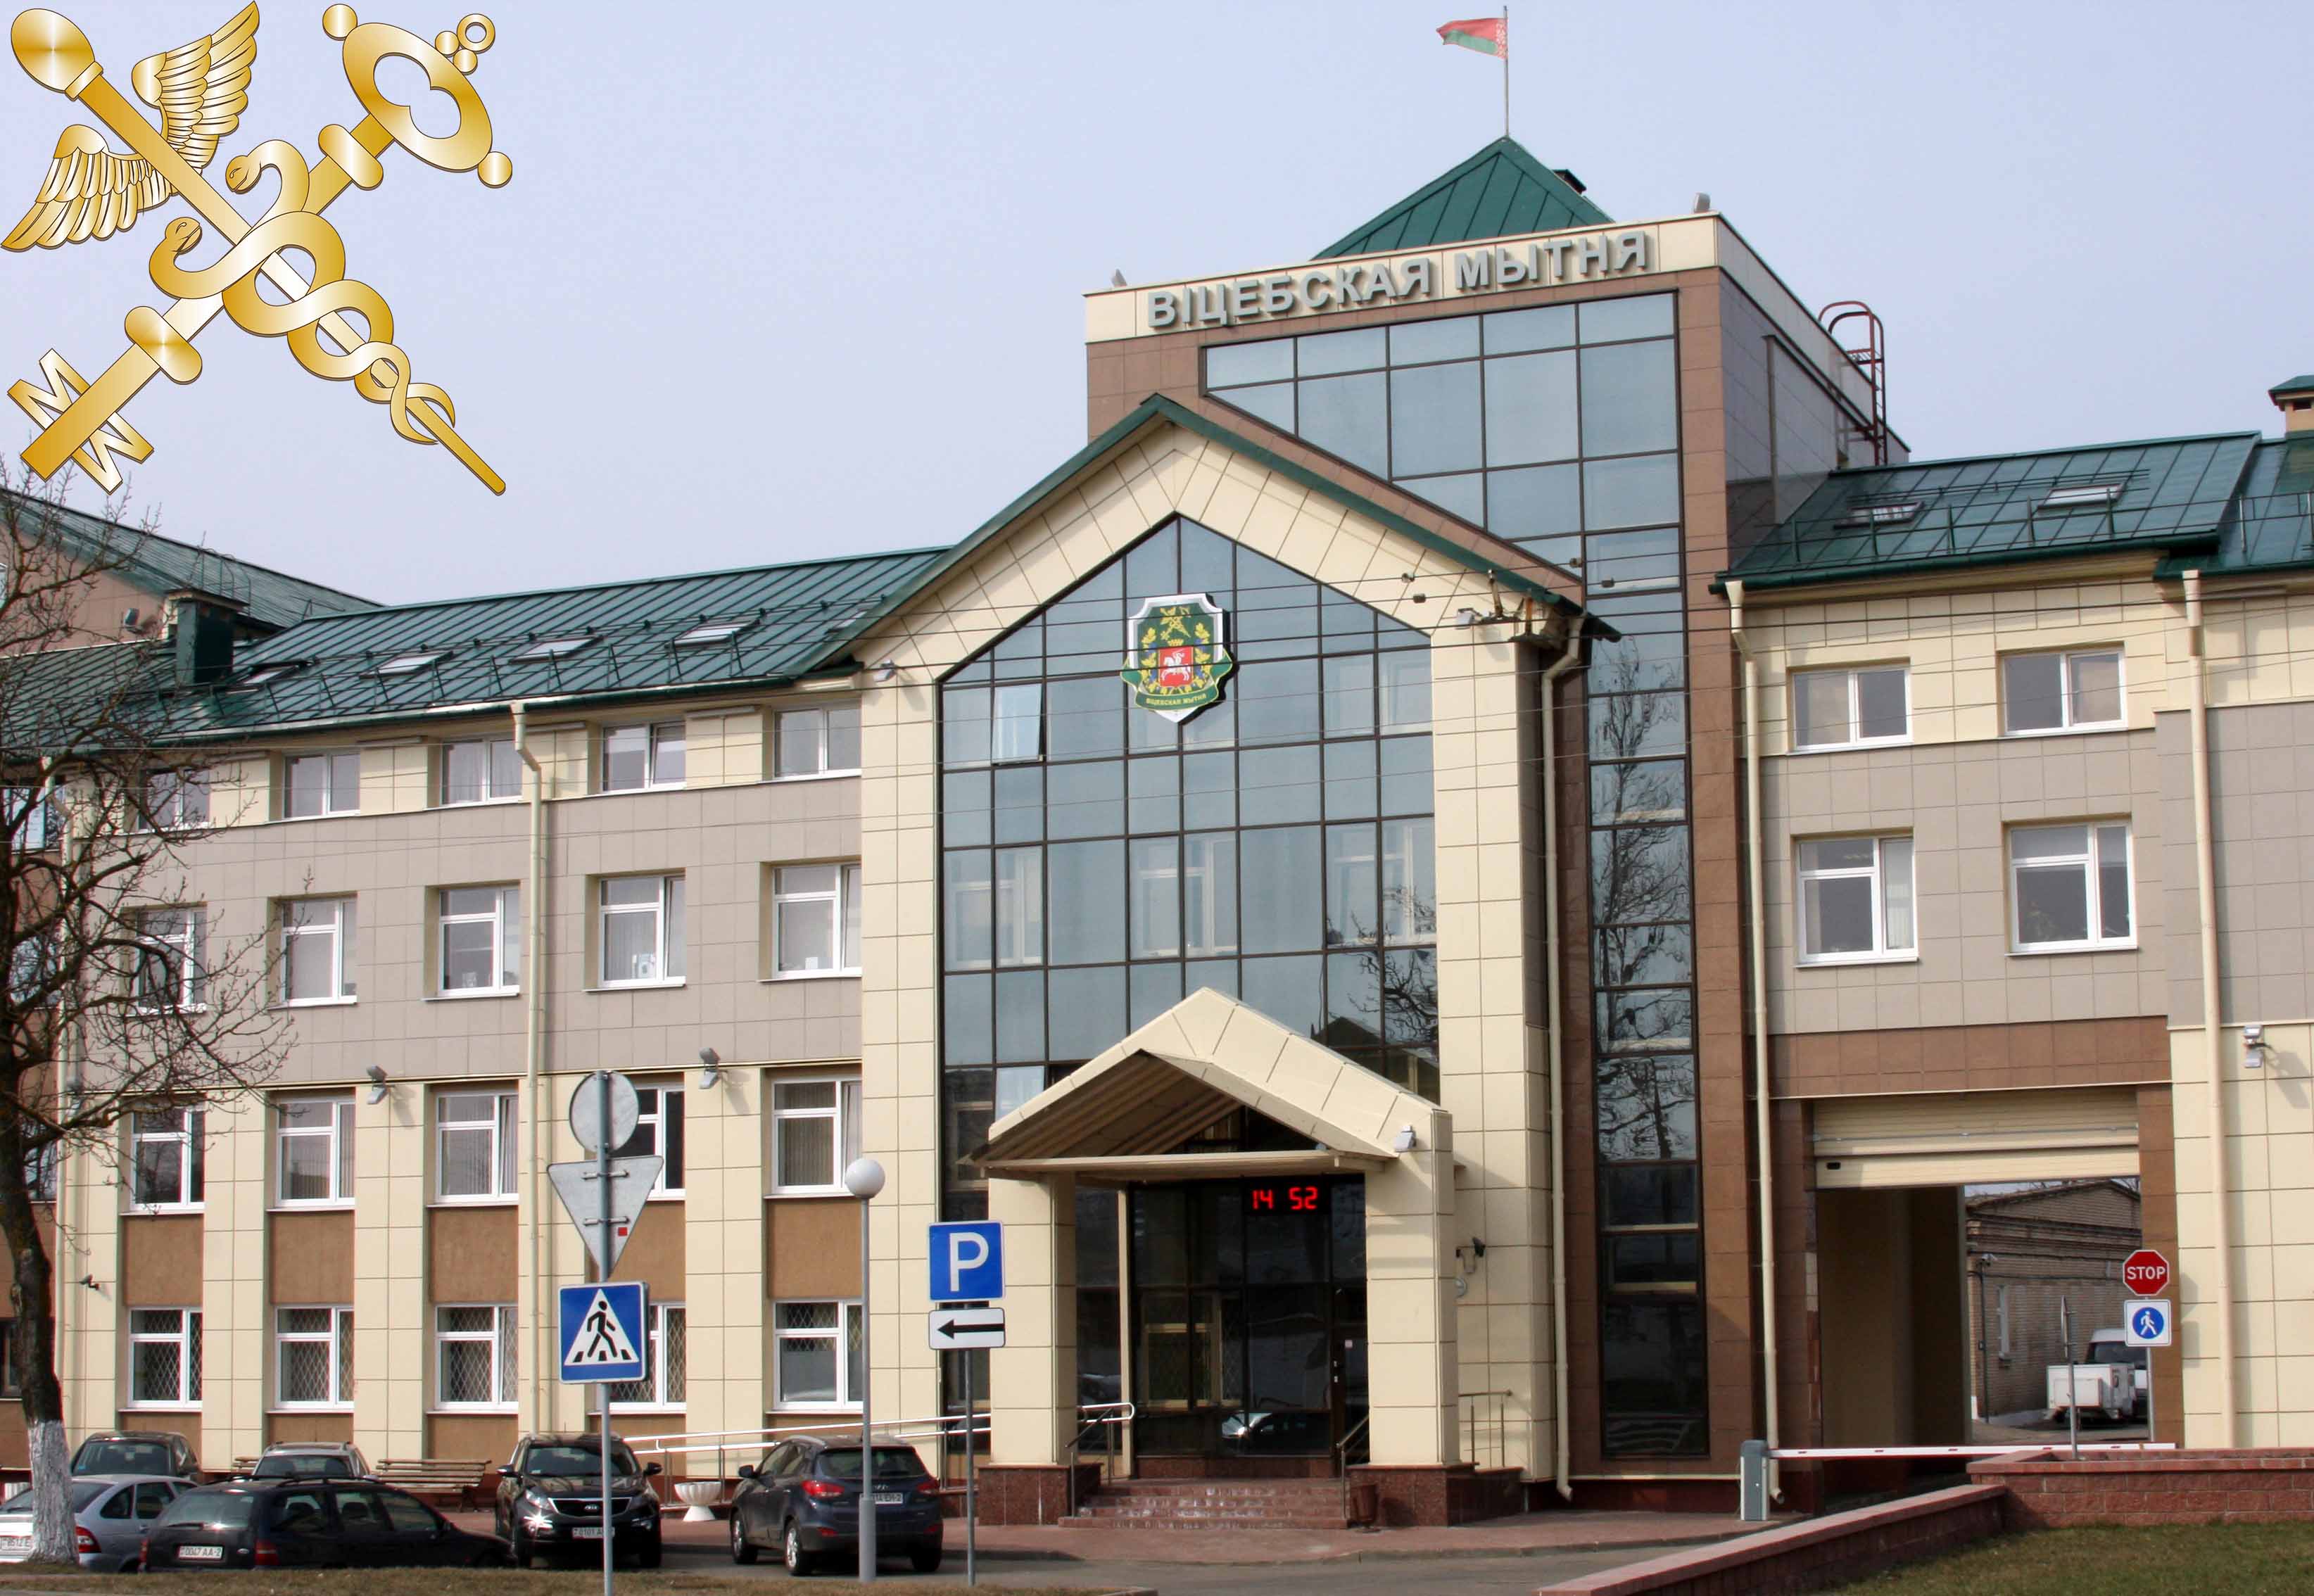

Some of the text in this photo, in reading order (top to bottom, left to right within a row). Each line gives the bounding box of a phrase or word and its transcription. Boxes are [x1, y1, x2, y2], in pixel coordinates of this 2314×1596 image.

[1147, 230, 1646, 328] ВІЦЕБСКАЯ МЫТНЯ
[1253, 1186, 1318, 1210] 14 52
[949, 1231, 990, 1292] P
[2127, 1266, 2166, 1280] STOP
